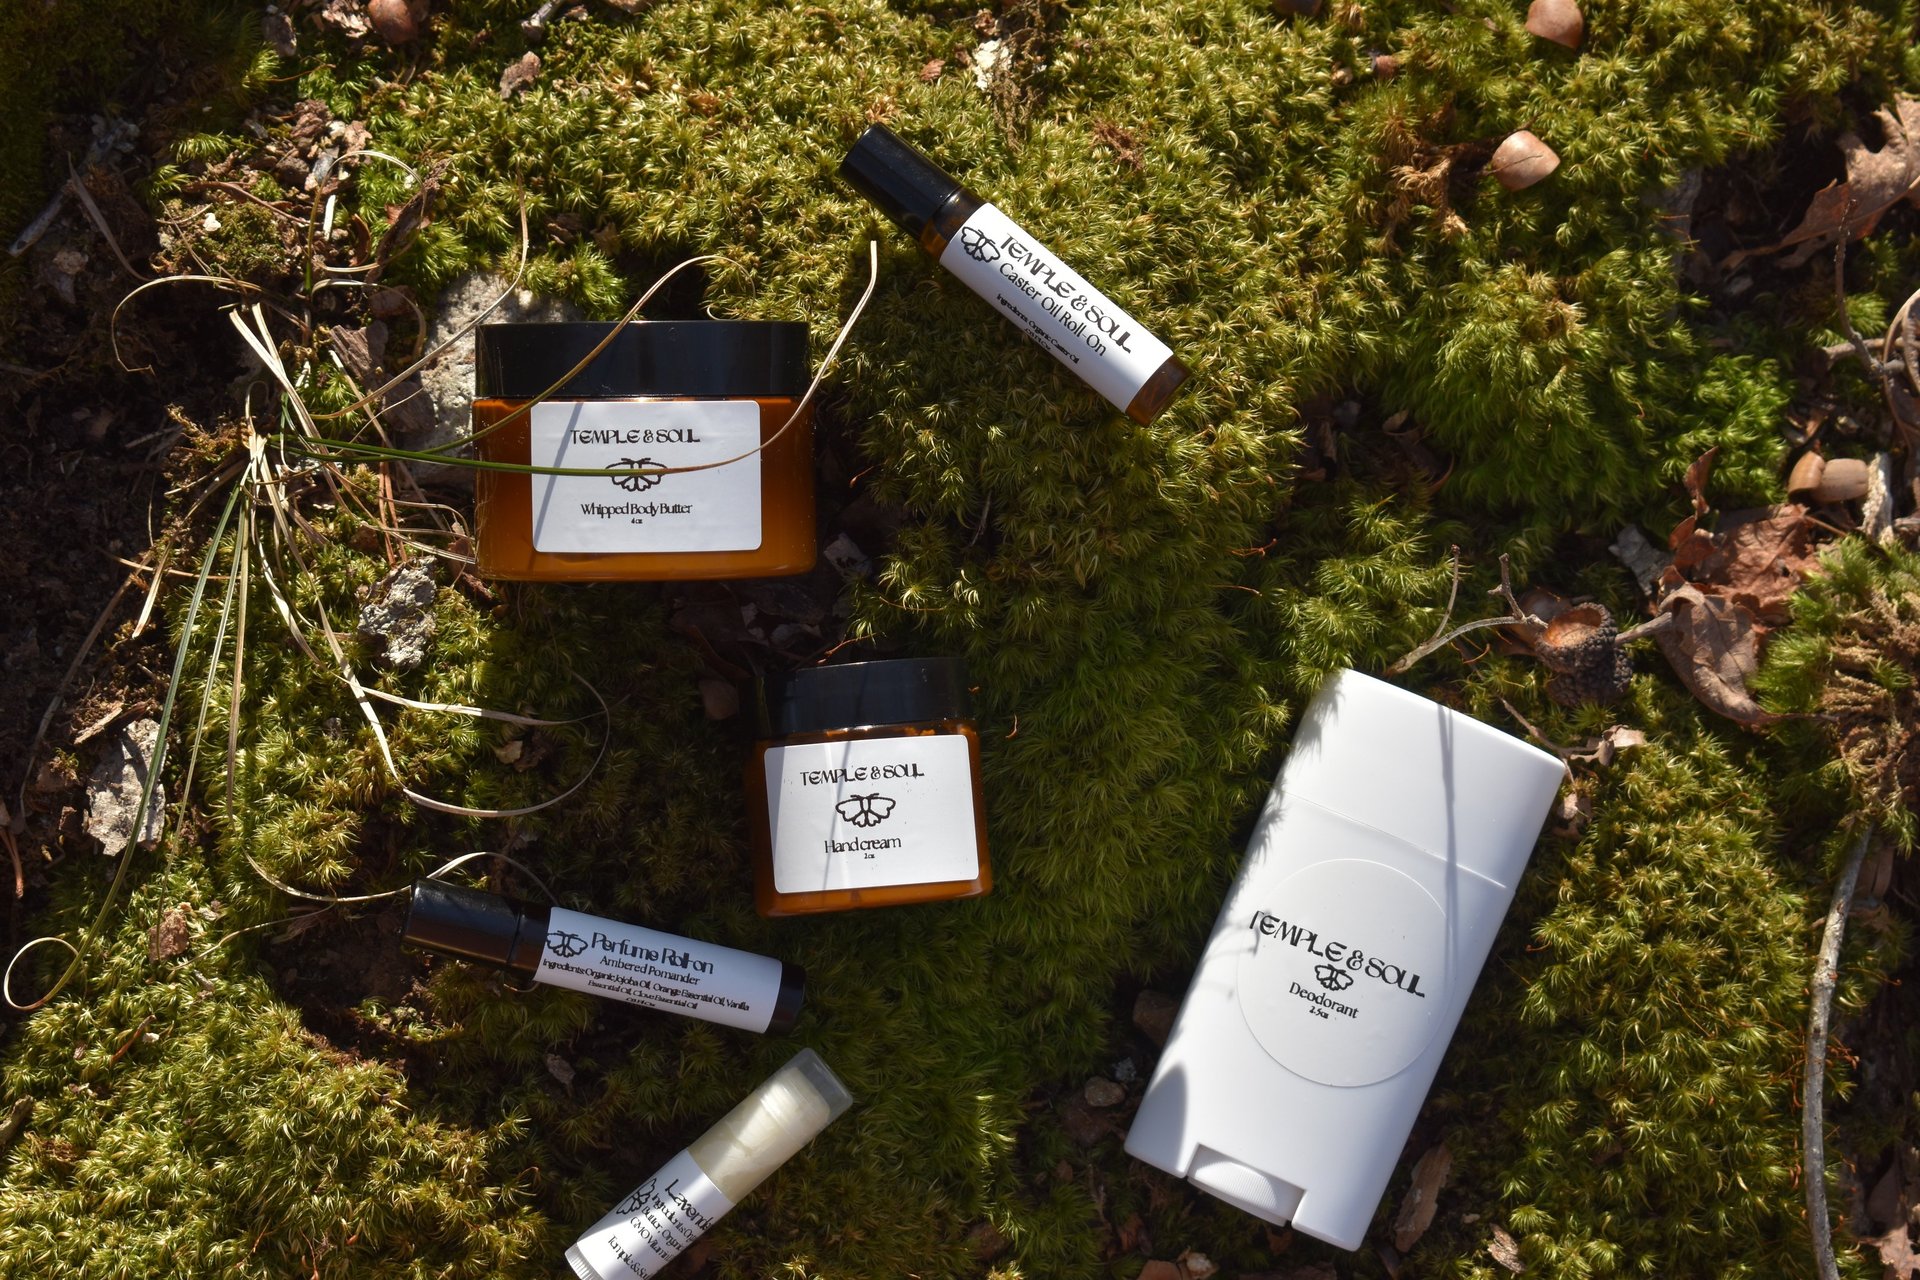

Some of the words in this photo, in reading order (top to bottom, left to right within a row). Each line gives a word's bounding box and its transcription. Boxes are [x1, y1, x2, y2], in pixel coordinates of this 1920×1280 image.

[1000, 233, 1076, 298] TEMPLE
[1071, 295, 1088, 311] &
[1085, 305, 1131, 354] SOUL
[1000, 263, 1042, 299] Caster
[1041, 297, 1063, 318] Oil
[1059, 311, 1106, 357] Roll-On
[570, 429, 640, 444] TEMPLE
[643, 430, 653, 443] &
[656, 429, 700, 444] SOUL
[581, 502, 629, 519] Whipped
[630, 501, 660, 517] Body
[660, 503, 693, 515] Butter
[800, 766, 868, 786] TEMPLE
[870, 766, 881, 780] &
[883, 763, 924, 780] SOUL
[592, 932, 659, 961] Perfume
[1249, 910, 1347, 962] TEMPLE
[1346, 950, 1364, 971] &
[1364, 957, 1425, 998] SOUL
[600, 956, 648, 974] Ambered
[648, 966, 700, 985] Pomander
[1289, 981, 1359, 1019] Deodorant
